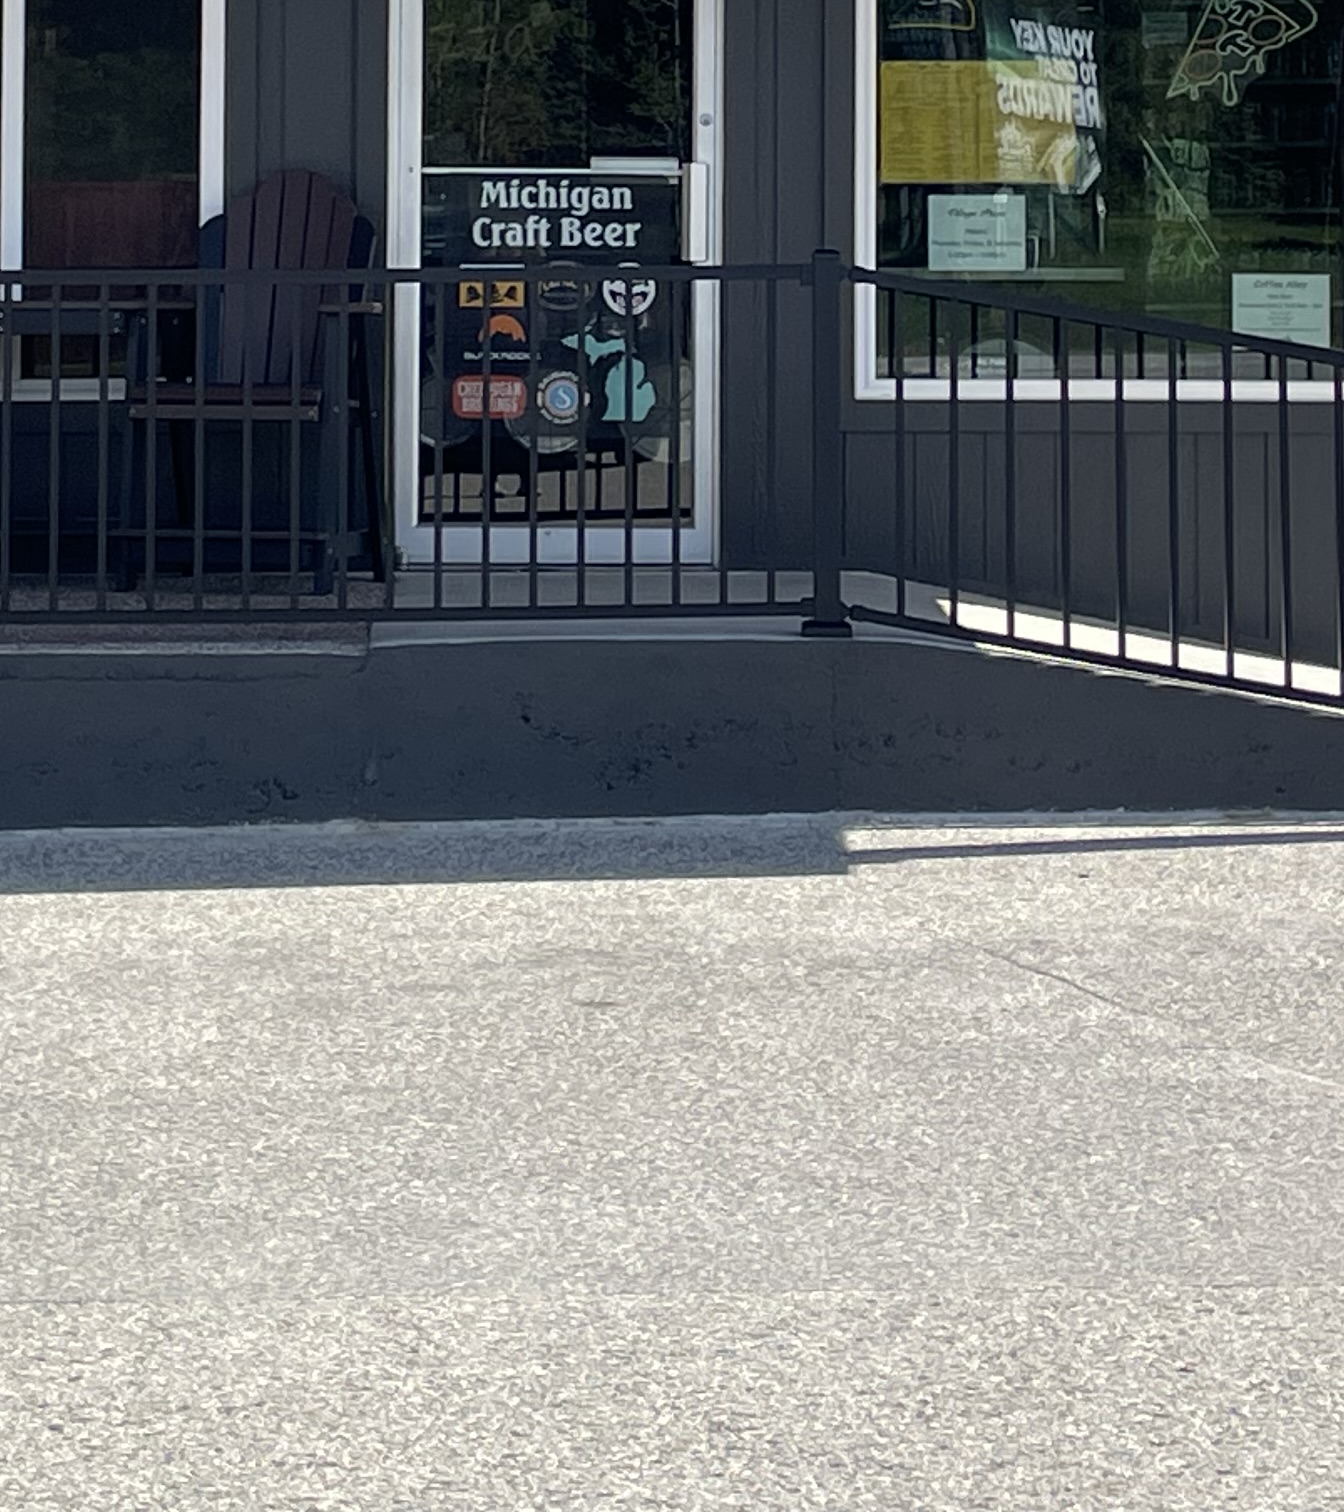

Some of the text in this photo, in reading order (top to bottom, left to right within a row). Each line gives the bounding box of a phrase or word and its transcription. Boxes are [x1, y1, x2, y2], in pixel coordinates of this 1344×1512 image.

[480, 178, 634, 217] Michigan
[472, 215, 643, 248] Craft Beer
